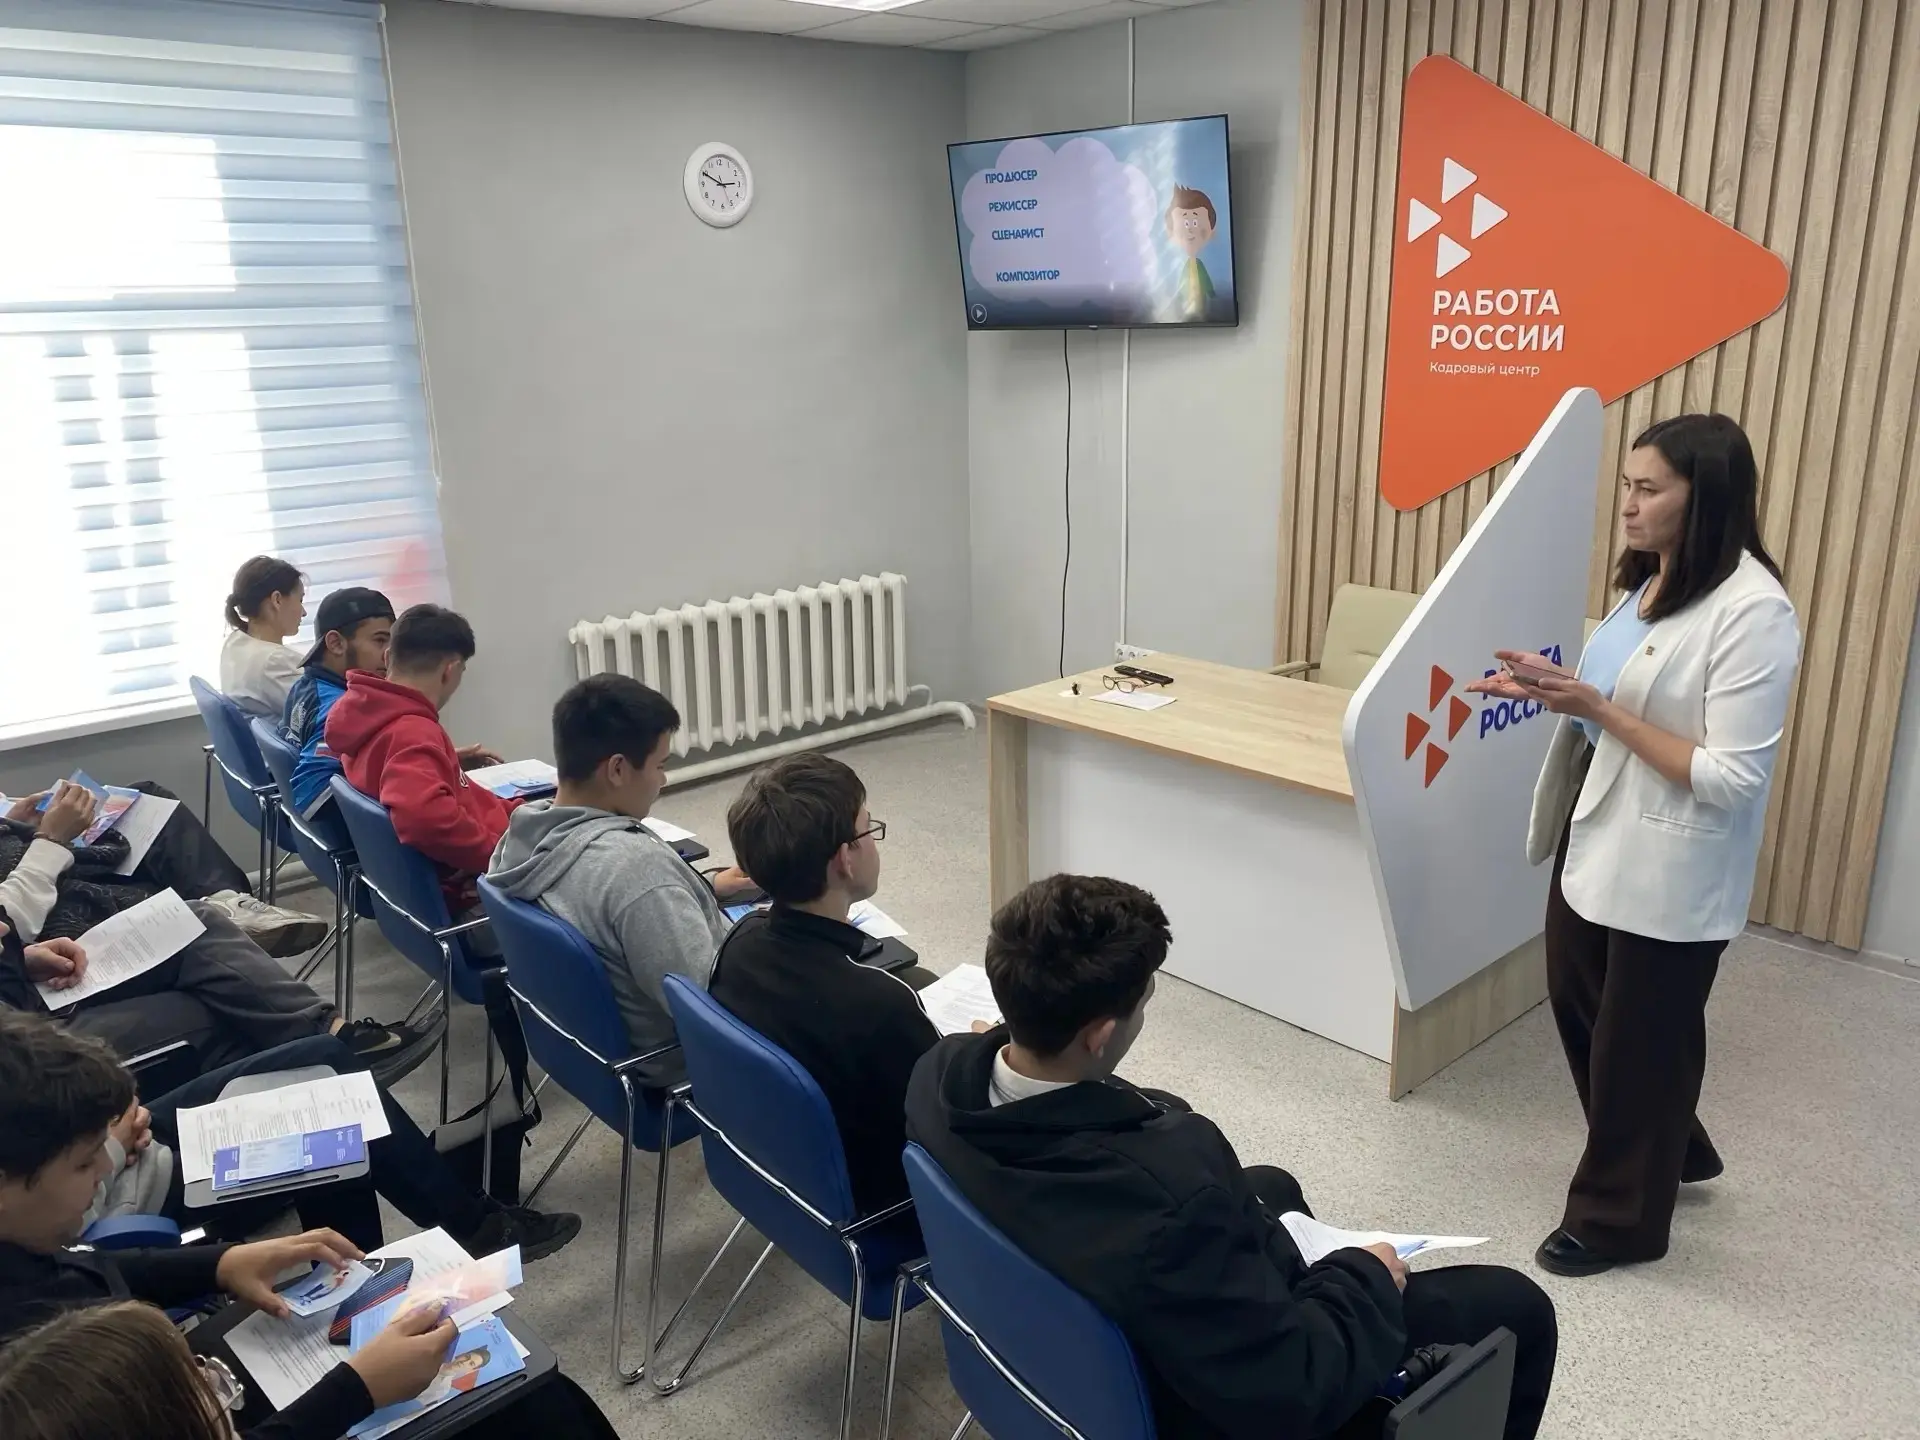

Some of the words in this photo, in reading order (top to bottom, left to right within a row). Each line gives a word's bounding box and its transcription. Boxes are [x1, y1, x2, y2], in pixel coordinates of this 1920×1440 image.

[985, 169, 1038, 184] ПРОДЮСЕР
[988, 199, 1038, 213] РЕЖИССЕР
[991, 227, 1045, 241] СЦЕНАРИСТ
[996, 269, 1060, 283] КОМПОЗИТОР
[1432, 288, 1561, 317] РАБОТА
[1430, 324, 1566, 352] РОССИИ
[1429, 361, 1496, 376] Кадровый
[1499, 363, 1540, 378] центр
